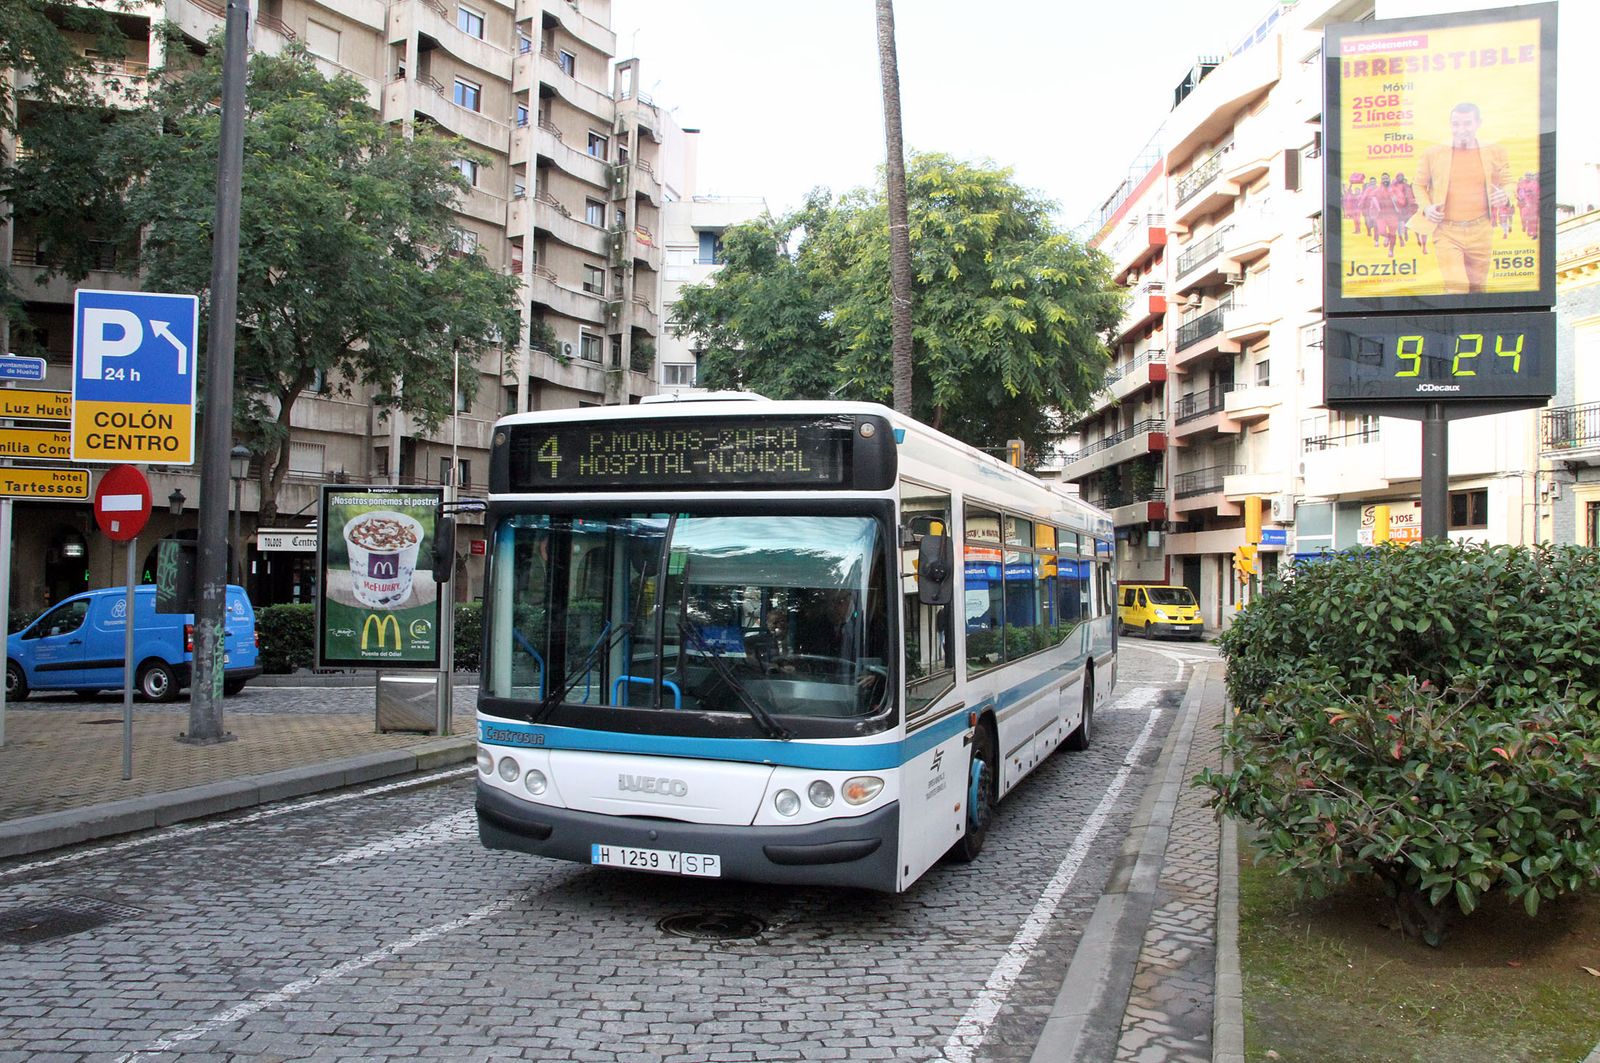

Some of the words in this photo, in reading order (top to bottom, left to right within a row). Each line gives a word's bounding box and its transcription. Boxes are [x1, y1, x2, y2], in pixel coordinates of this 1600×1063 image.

[1358, 39, 1419, 51] Doblemente
[1343, 44, 1536, 78] IRRESISTIBLE
[1383, 81, 1414, 92] Móvil
[1352, 94, 1400, 109] 25GB
[1352, 111, 1362, 122] 2
[1366, 109, 1414, 122] líneas
[1383, 133, 1414, 141] Fibra
[1367, 143, 1414, 155] 100Mb
[1514, 248, 1536, 256] gratis
[1346, 258, 1417, 277] Jazztel
[1493, 256, 1535, 269] 1568
[1493, 270, 1535, 278] jazztel.com
[82, 307, 143, 379] P
[1394, 335, 1425, 377] 9
[104, 367, 125, 380] 24
[130, 368, 140, 381] h
[1415, 383, 1460, 392] JCDecaux
[55, 396, 72, 404] ho
[5, 402, 30, 414] Luz
[94, 409, 173, 430] COLÓN
[54, 433, 71, 442] ho
[86, 433, 179, 452] CENTRO
[537, 434, 562, 478] 4
[53, 473, 83, 481] hotel
[5, 480, 82, 493] Tartessos
[332, 496, 368, 506] ¡Nosotros
[369, 498, 402, 507] ponemos
[404, 497, 411, 506] el
[486, 725, 545, 745] Castrosua
[618, 773, 688, 797] IVECO
[601, 847, 610, 863] H
[620, 849, 659, 867] 1259
[668, 854, 677, 870] Y
[686, 855, 715, 873] SP
